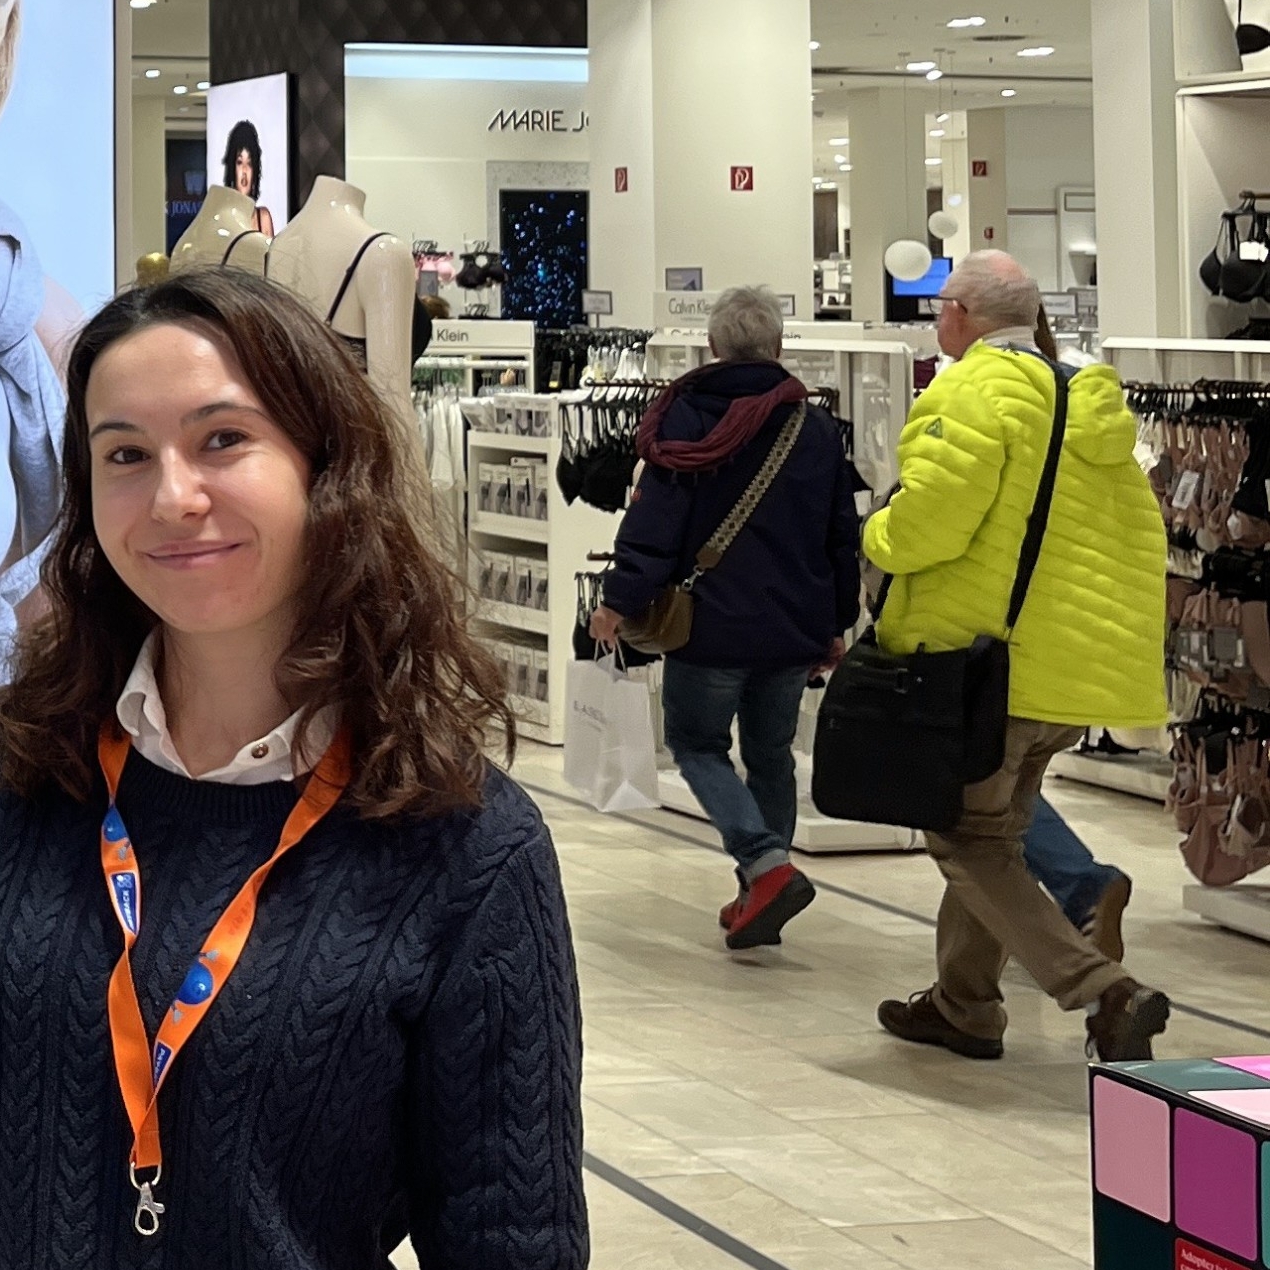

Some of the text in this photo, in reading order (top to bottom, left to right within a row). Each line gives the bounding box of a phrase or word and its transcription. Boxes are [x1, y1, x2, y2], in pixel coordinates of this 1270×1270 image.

[487, 109, 590, 132] MARIE J
[436, 329, 469, 342] Klein
